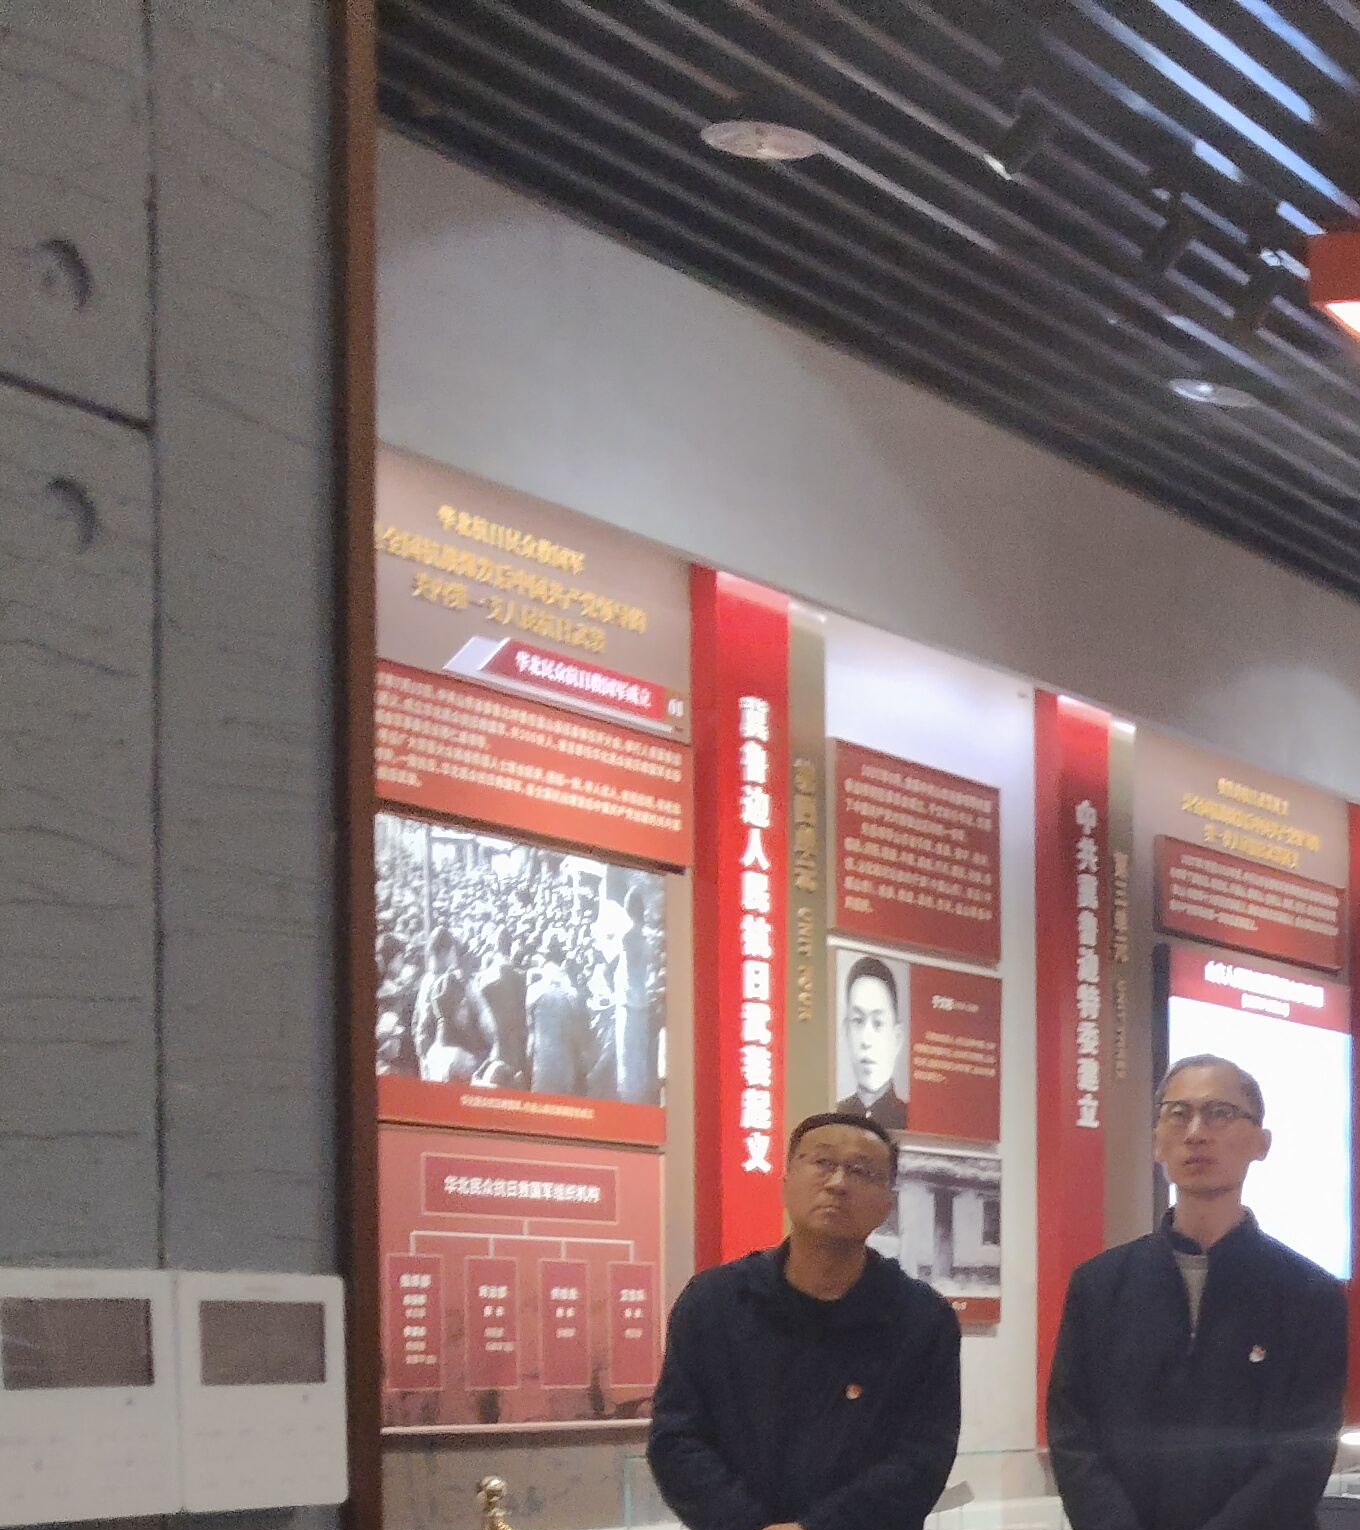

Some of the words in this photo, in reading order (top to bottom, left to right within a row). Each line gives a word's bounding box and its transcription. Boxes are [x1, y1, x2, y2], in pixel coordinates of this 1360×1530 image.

[738, 695, 773, 1174] 冀鲁边人民抗日武装起义
